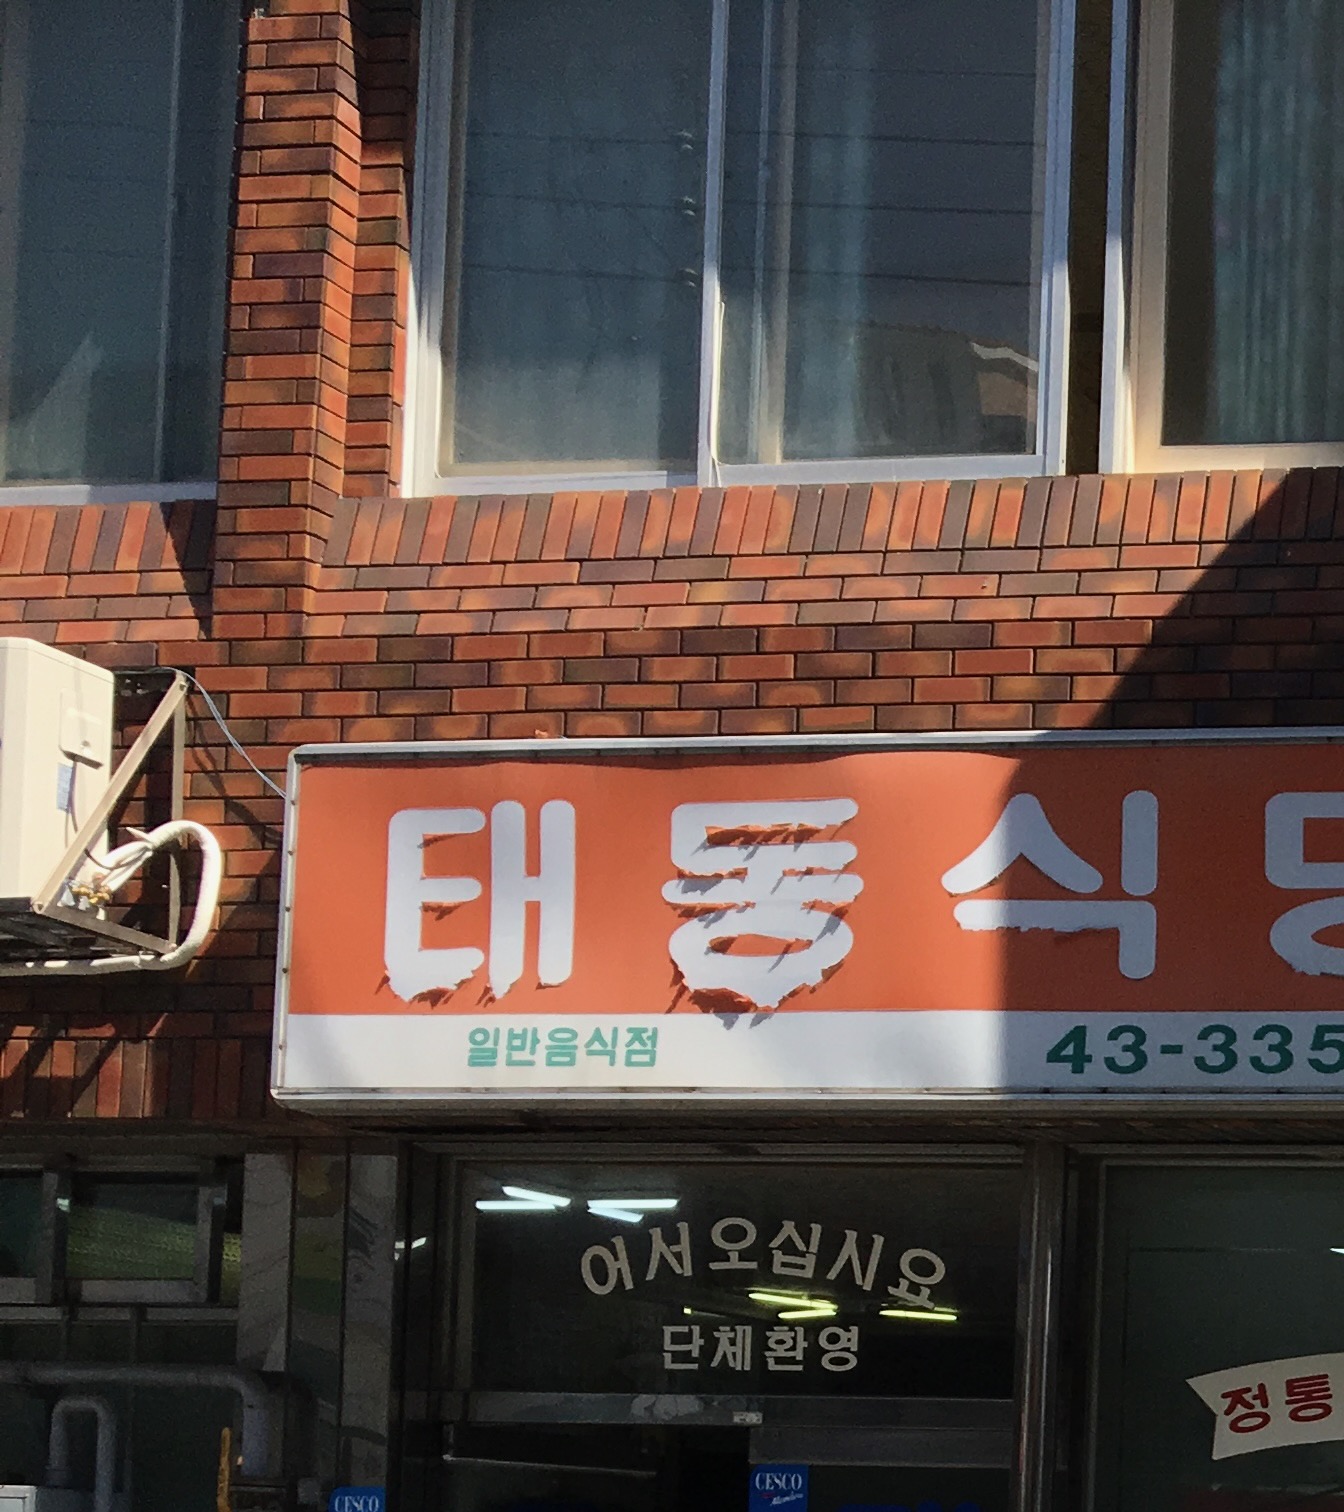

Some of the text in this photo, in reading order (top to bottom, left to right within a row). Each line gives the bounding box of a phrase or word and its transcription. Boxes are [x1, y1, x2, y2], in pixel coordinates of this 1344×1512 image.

[467, 1025, 659, 1069] 일반음식점
[580, 1215, 948, 1310] 어서오십시요
[661, 1323, 861, 1373] 단체환영
[754, 1472, 804, 1491] CESCO
